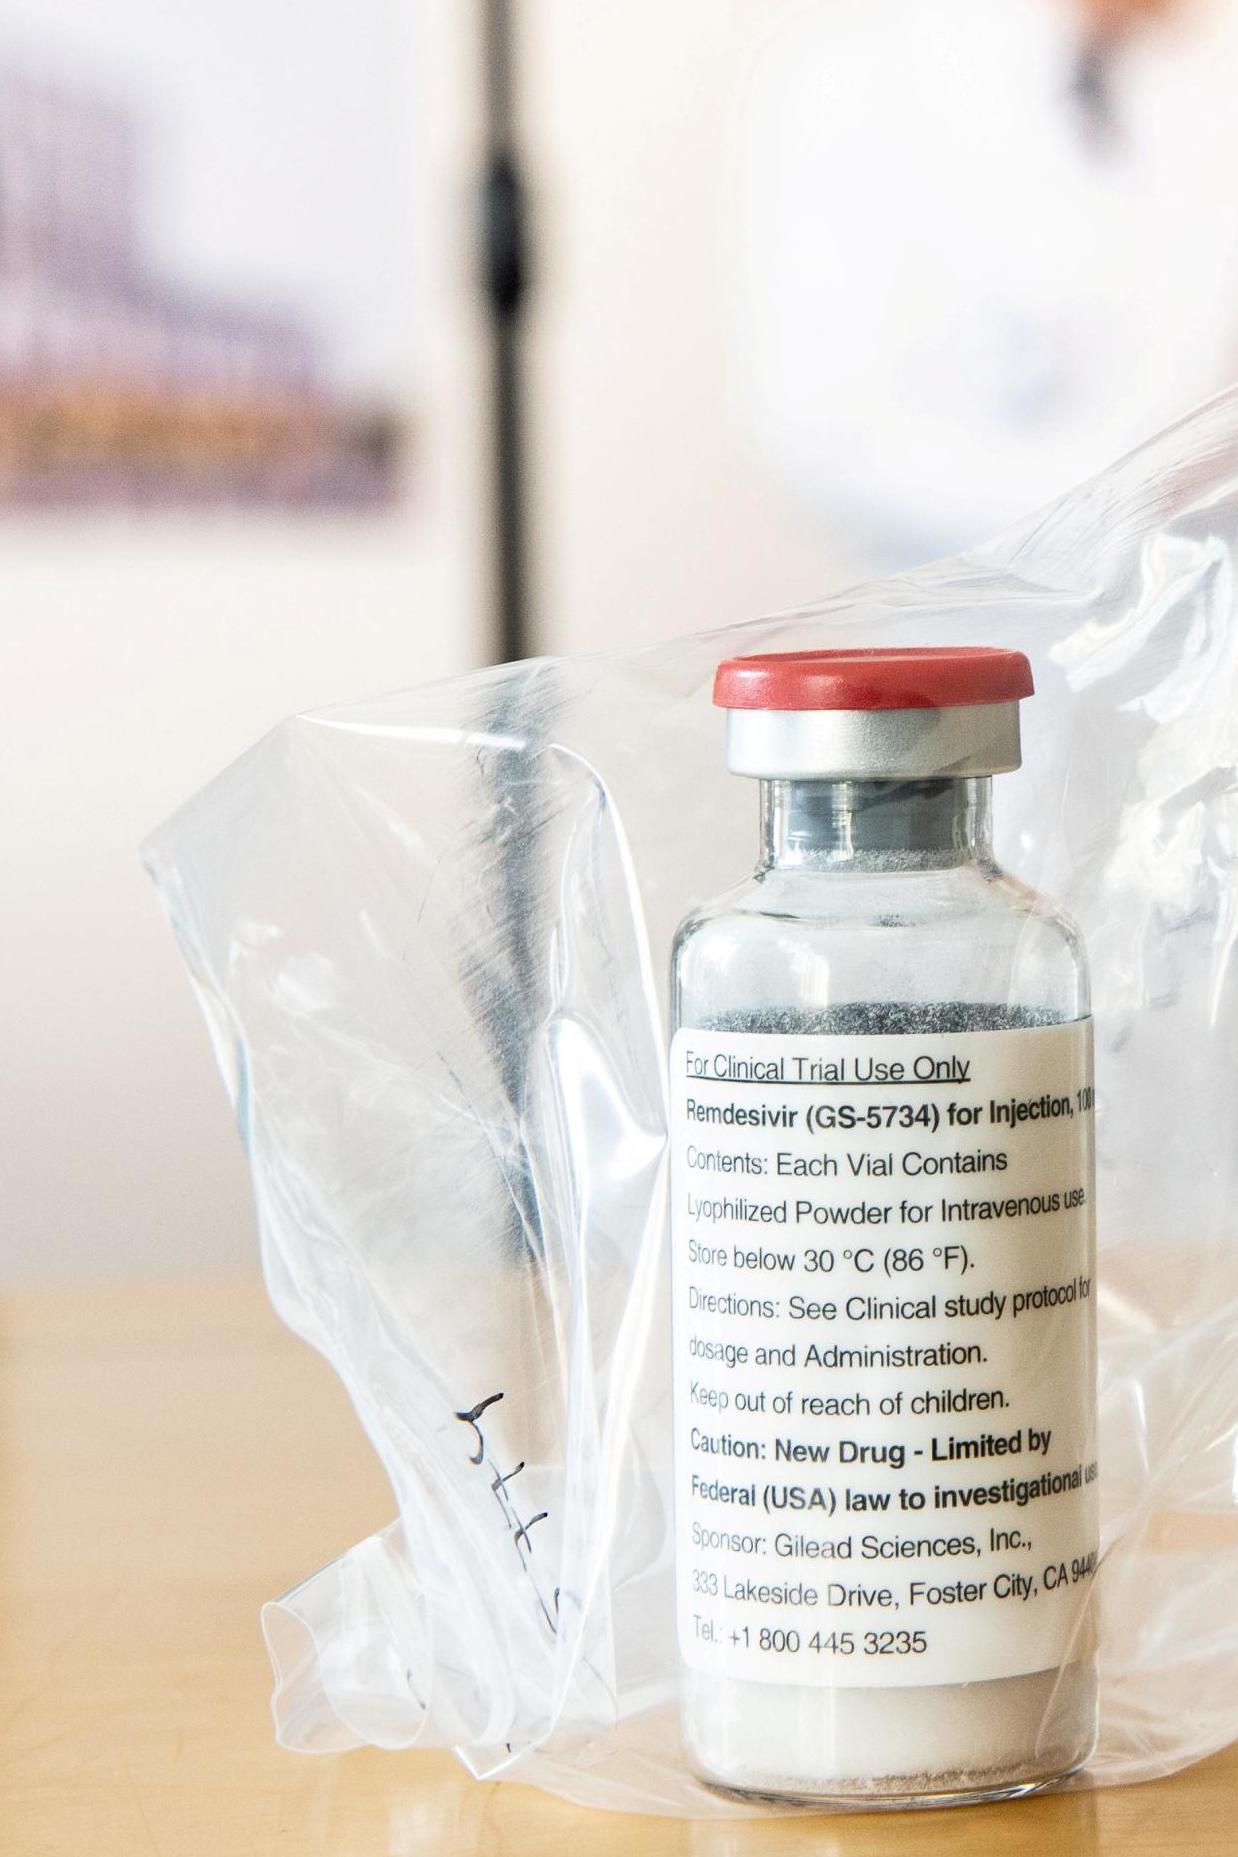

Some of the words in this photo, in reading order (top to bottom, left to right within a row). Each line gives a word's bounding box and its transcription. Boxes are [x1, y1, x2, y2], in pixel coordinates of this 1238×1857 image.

[686, 1051, 708, 1077] For
[713, 1053, 785, 1080] Clinical
[796, 1056, 845, 1081] Trial
[855, 1056, 905, 1081] Use
[913, 1055, 970, 1084] Only
[687, 1099, 798, 1127] Remdesivir
[806, 1103, 940, 1134] (GS-5734)
[947, 1102, 983, 1126] for
[990, 1094, 1073, 1129] Injection,
[688, 1146, 768, 1175] Contents:
[777, 1152, 837, 1176] Each
[847, 1153, 893, 1176] Vial
[902, 1149, 1007, 1176] Contains
[689, 1197, 786, 1223] Lyophilized
[796, 1201, 892, 1225] Powder
[899, 1200, 933, 1223] for
[942, 1193, 1060, 1222] Intravenous
[689, 1239, 728, 1267] Store
[734, 1246, 795, 1271] below
[804, 1249, 834, 1272] 30
[884, 1248, 924, 1278] (86
[689, 1286, 780, 1318] Directions:
[789, 1296, 837, 1320] See
[846, 1295, 936, 1321] Clinical
[944, 1291, 1007, 1320] study
[1013, 1278, 1076, 1318] protocol
[1079, 1277, 1091, 1299] for
[689, 1336, 749, 1368] dosage
[755, 1342, 795, 1367] and
[804, 1342, 987, 1368] Administration.
[690, 1381, 729, 1412] Keep
[735, 1392, 765, 1412] out
[773, 1391, 793, 1414] of
[802, 1393, 870, 1416] reach
[879, 1391, 903, 1415] of
[911, 1388, 1009, 1415] children.
[691, 1427, 765, 1460] Caution:
[776, 1438, 830, 1463] New
[839, 1441, 905, 1469] Drug
[932, 1430, 1021, 1461] Limited
[1028, 1428, 1052, 1456] by
[692, 1475, 755, 1507] Federal
[763, 1485, 836, 1517] (USA)
[846, 1488, 891, 1511] law
[898, 1489, 926, 1510] to
[935, 1465, 1082, 1508] investigational
[693, 1522, 766, 1555] Sponsor:
[775, 1533, 852, 1559] Gilead
[861, 1535, 981, 1559] Sciences,
[990, 1528, 1031, 1552] Inc.,
[693, 1569, 718, 1596] 333
[724, 1581, 818, 1606] Lakeside
[828, 1584, 899, 1610] Drive,
[910, 1581, 987, 1605] Foster
[994, 1573, 1037, 1601] City,
[1043, 1562, 1068, 1590] CA
[730, 1626, 749, 1648] +1
[759, 1628, 800, 1653] 800
[808, 1632, 854, 1655] 445
[864, 1630, 927, 1655] 3235
